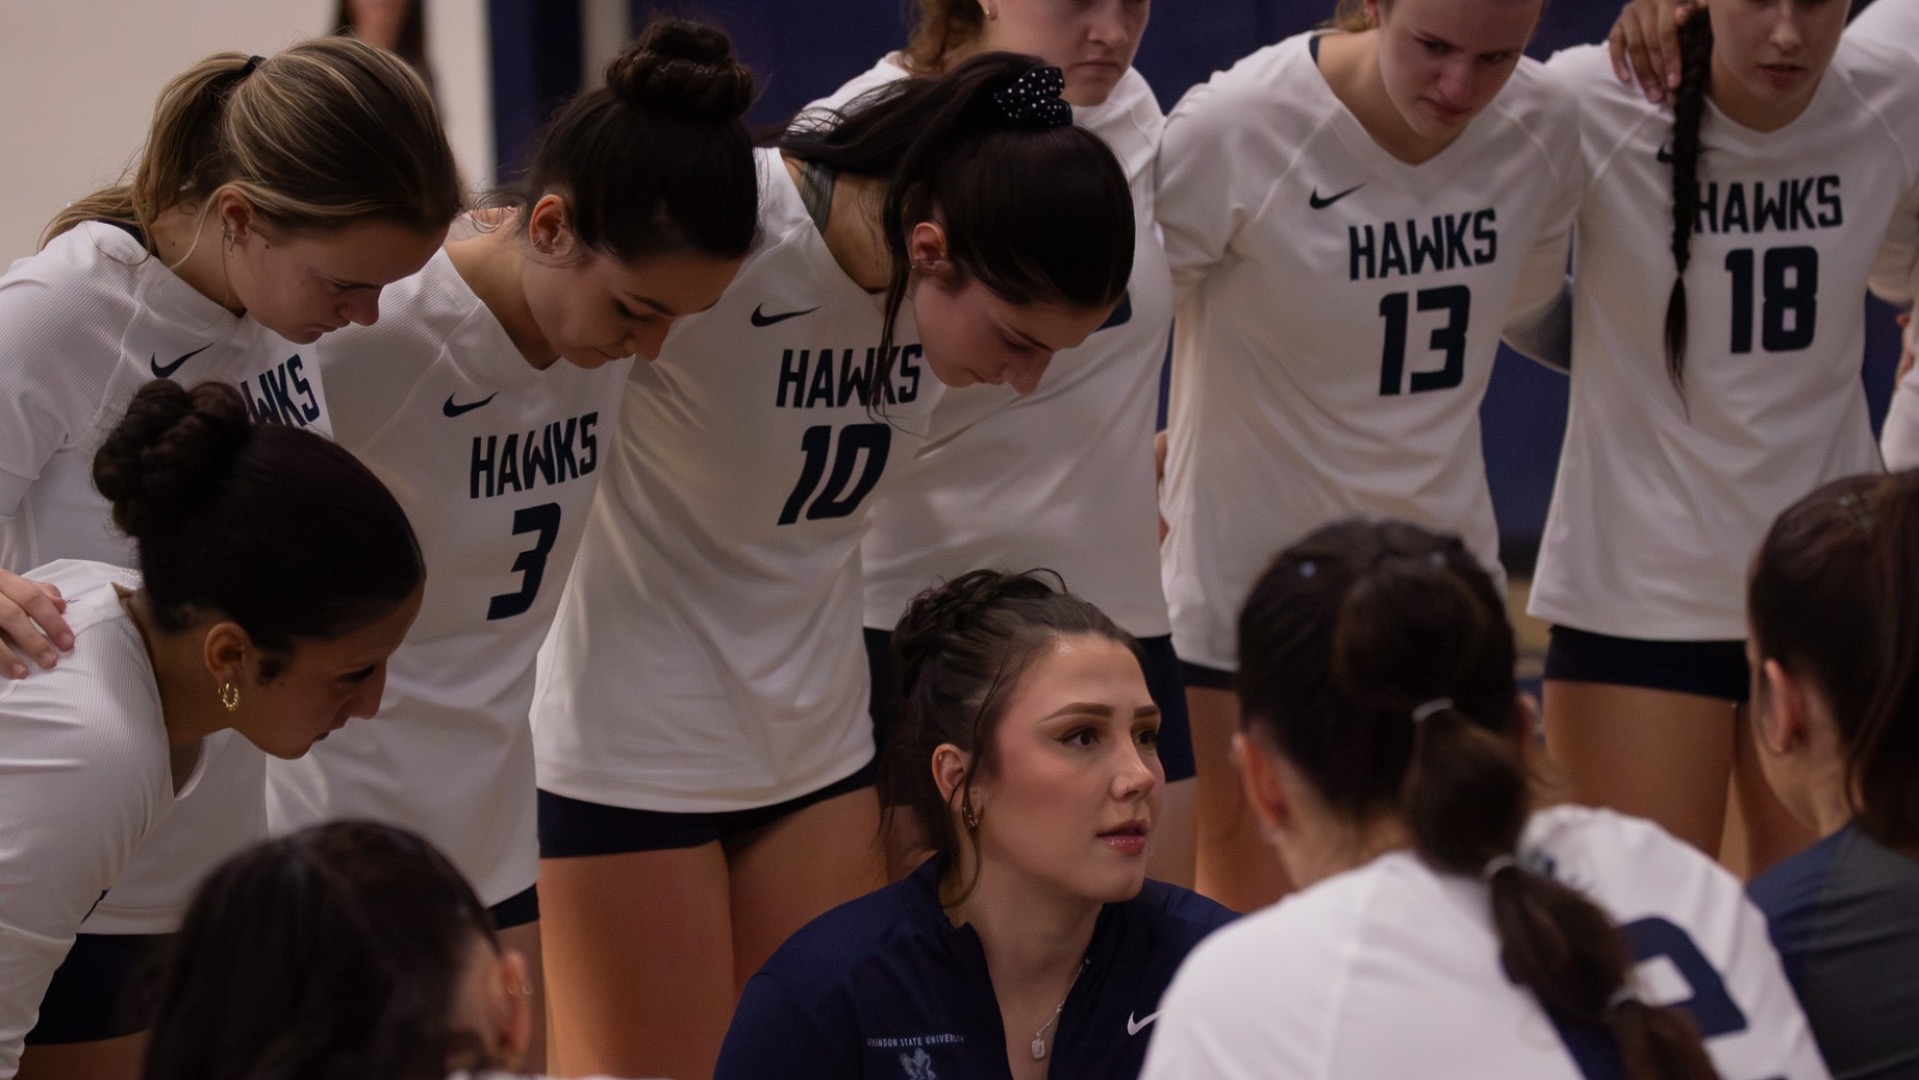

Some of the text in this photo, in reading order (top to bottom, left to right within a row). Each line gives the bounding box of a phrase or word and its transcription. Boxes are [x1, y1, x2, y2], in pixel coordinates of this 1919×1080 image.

[1349, 207, 1498, 281] HAWKS
[1695, 175, 1843, 234] HAWKS
[1379, 284, 1471, 396] 13
[1725, 246, 1819, 354] 18
[240, 354, 320, 428] WKS
[776, 344, 922, 408] HAWKS
[470, 411, 598, 499] HAWKS
[777, 423, 892, 525] 10
[486, 502, 561, 621] 3
[900, 1037, 923, 1047] STATE
